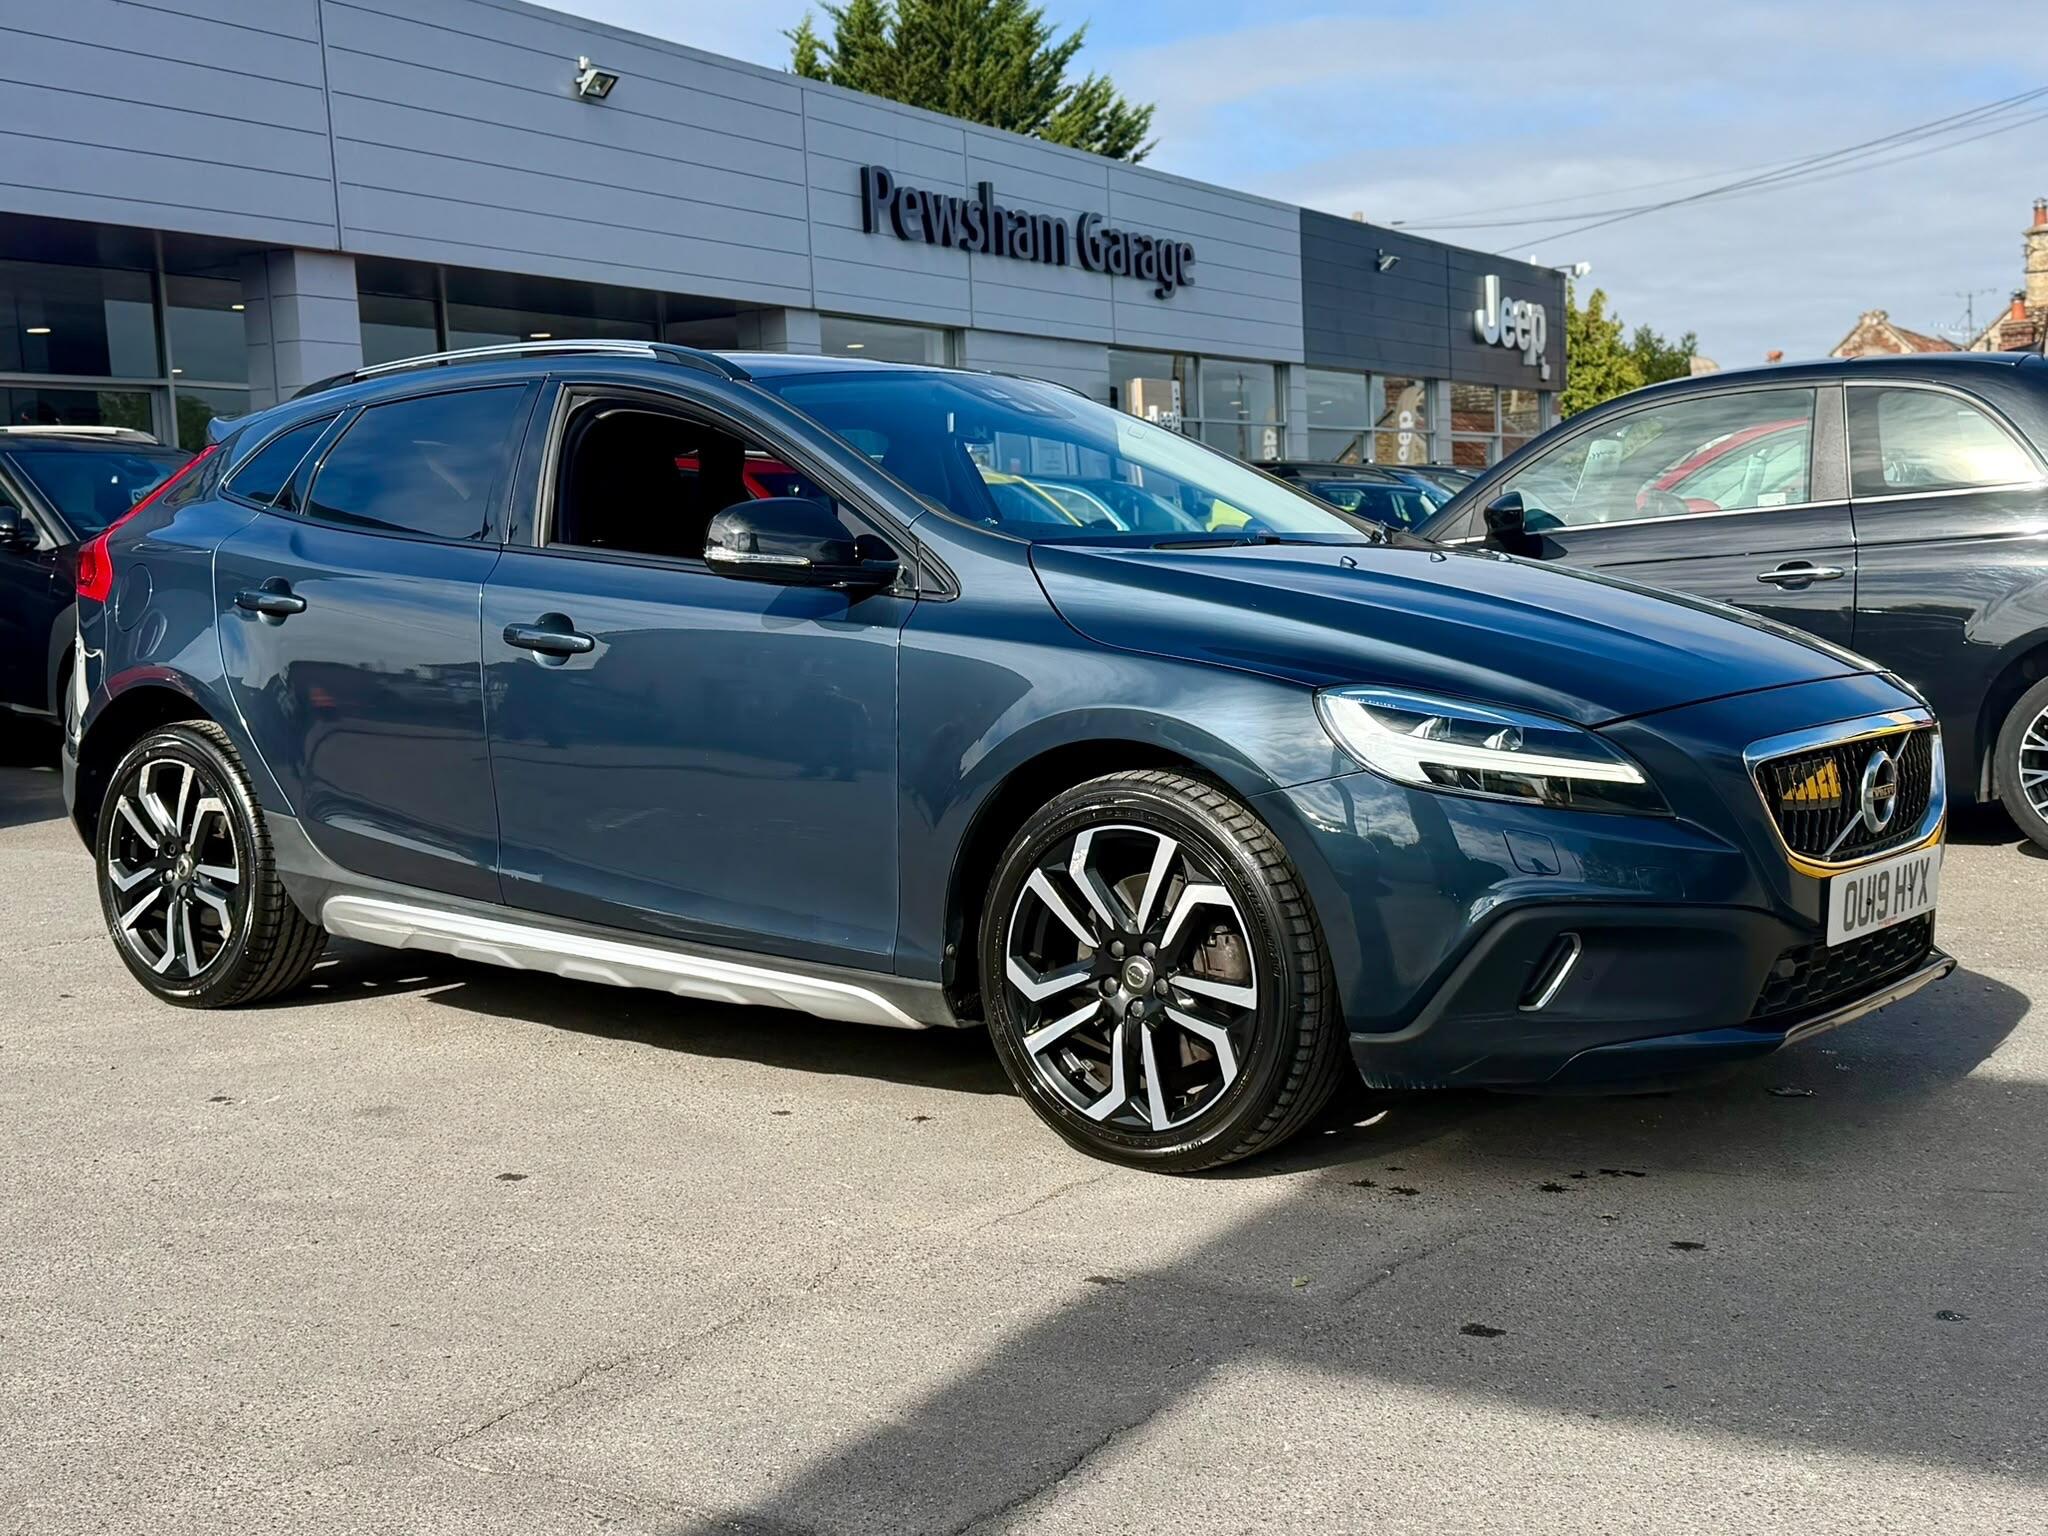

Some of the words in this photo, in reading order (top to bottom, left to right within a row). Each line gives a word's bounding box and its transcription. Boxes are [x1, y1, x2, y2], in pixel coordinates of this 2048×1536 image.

[860, 165, 1071, 267] Pewsham
[1076, 212, 1196, 300] Garage
[1474, 274, 1546, 366] Jeep
[1397, 410, 1415, 465] eep
[1843, 870, 1890, 933] OU19
[1893, 857, 1930, 915] HYX
